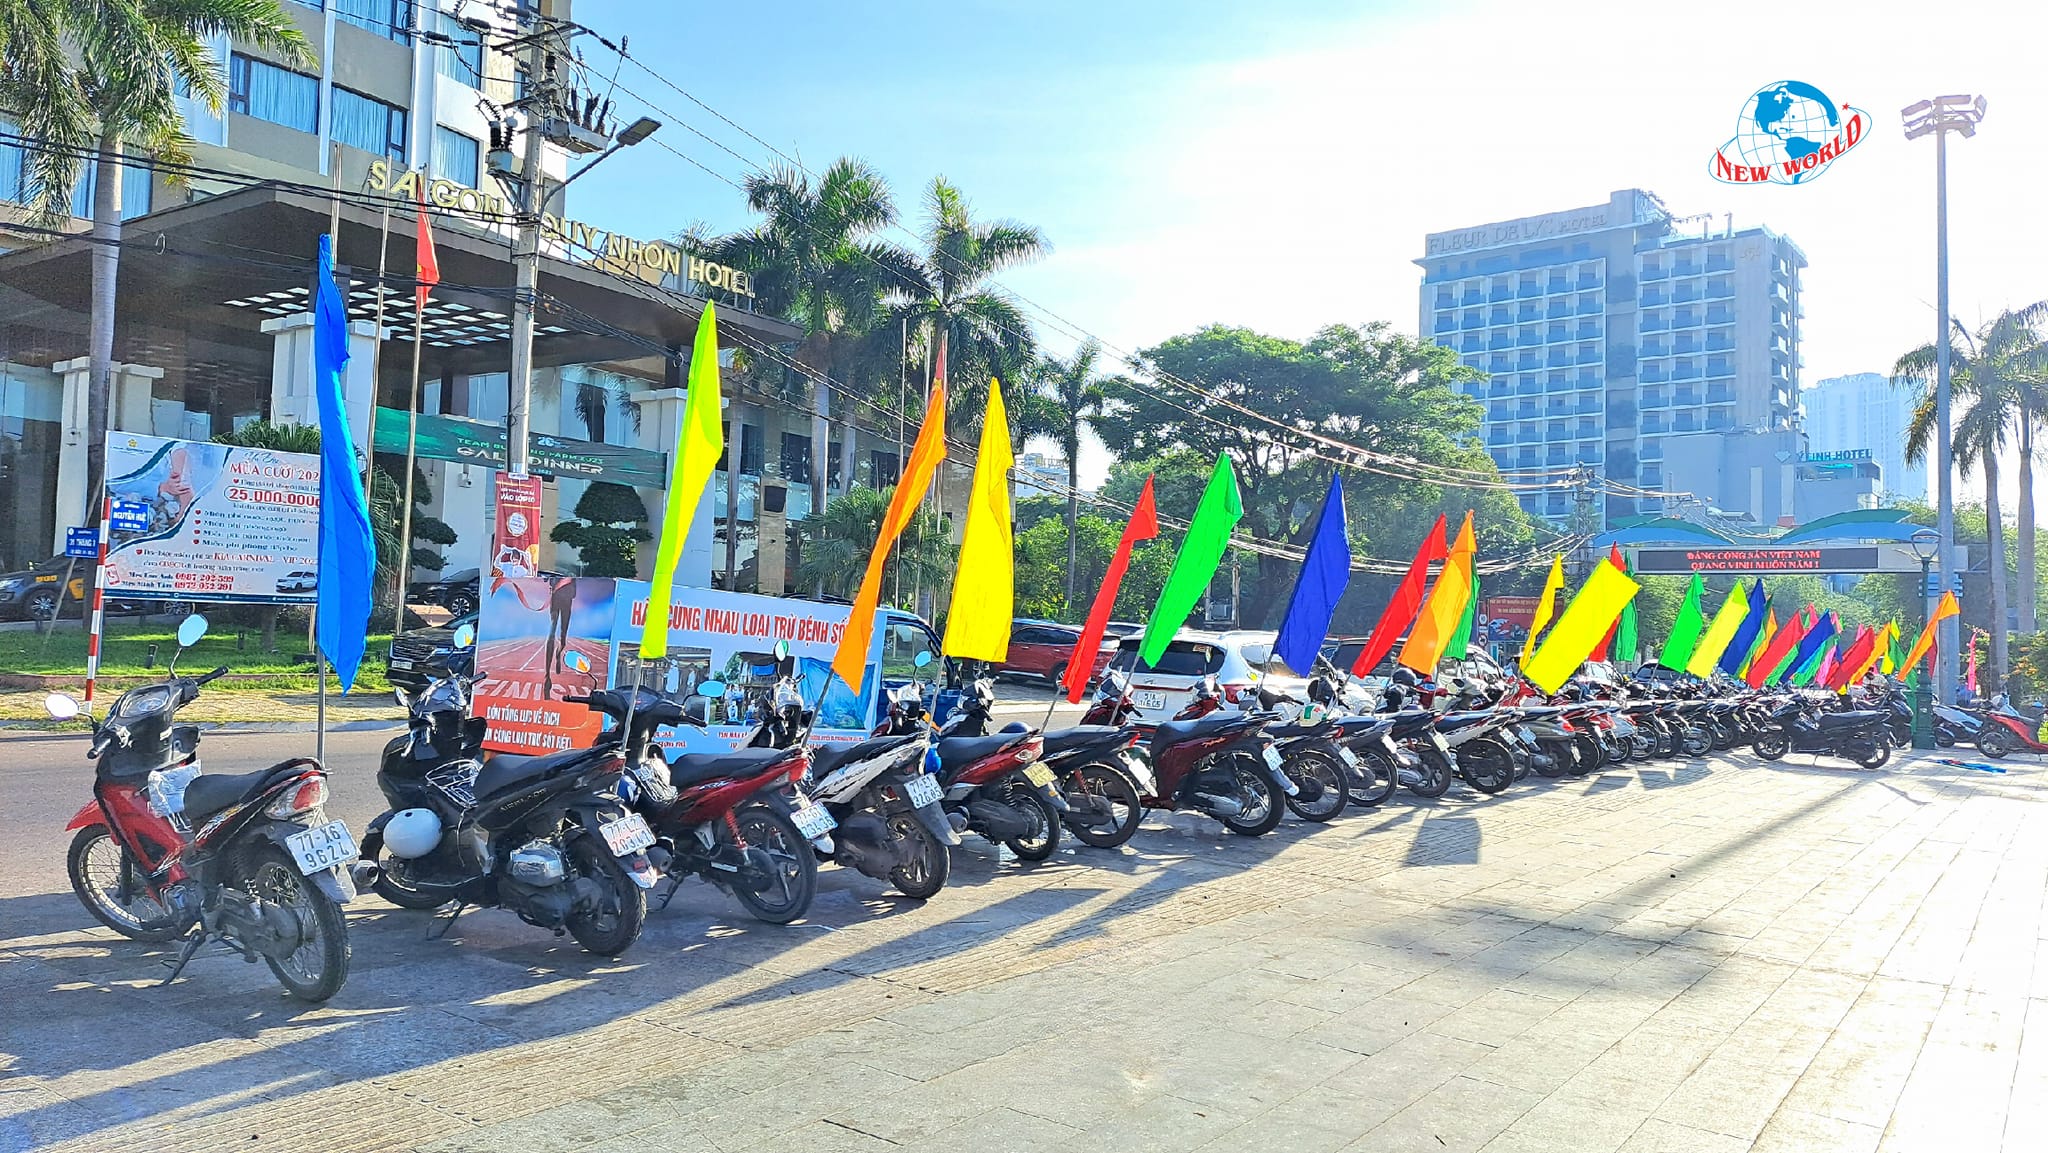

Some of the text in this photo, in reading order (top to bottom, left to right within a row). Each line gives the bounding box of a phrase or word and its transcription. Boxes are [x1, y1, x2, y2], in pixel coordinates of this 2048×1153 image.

[1428, 231, 1486, 252] FLEUR
[1494, 225, 1519, 243] DE
[1559, 215, 1608, 232] HOTEL
[606, 231, 680, 275] NHON
[689, 258, 756, 298] HOTEL
[457, 447, 505, 461] GAL
[1691, 561, 1726, 570] QUANG
[1728, 561, 1753, 569] VINH
[704, 608, 739, 635] NHAU
[743, 615, 769, 642] LOẠI
[773, 613, 797, 640] TRỪ
[797, 619, 828, 647] BỆNH
[296, 825, 341, 852] 77-X6
[305, 842, 350, 868] 9624
